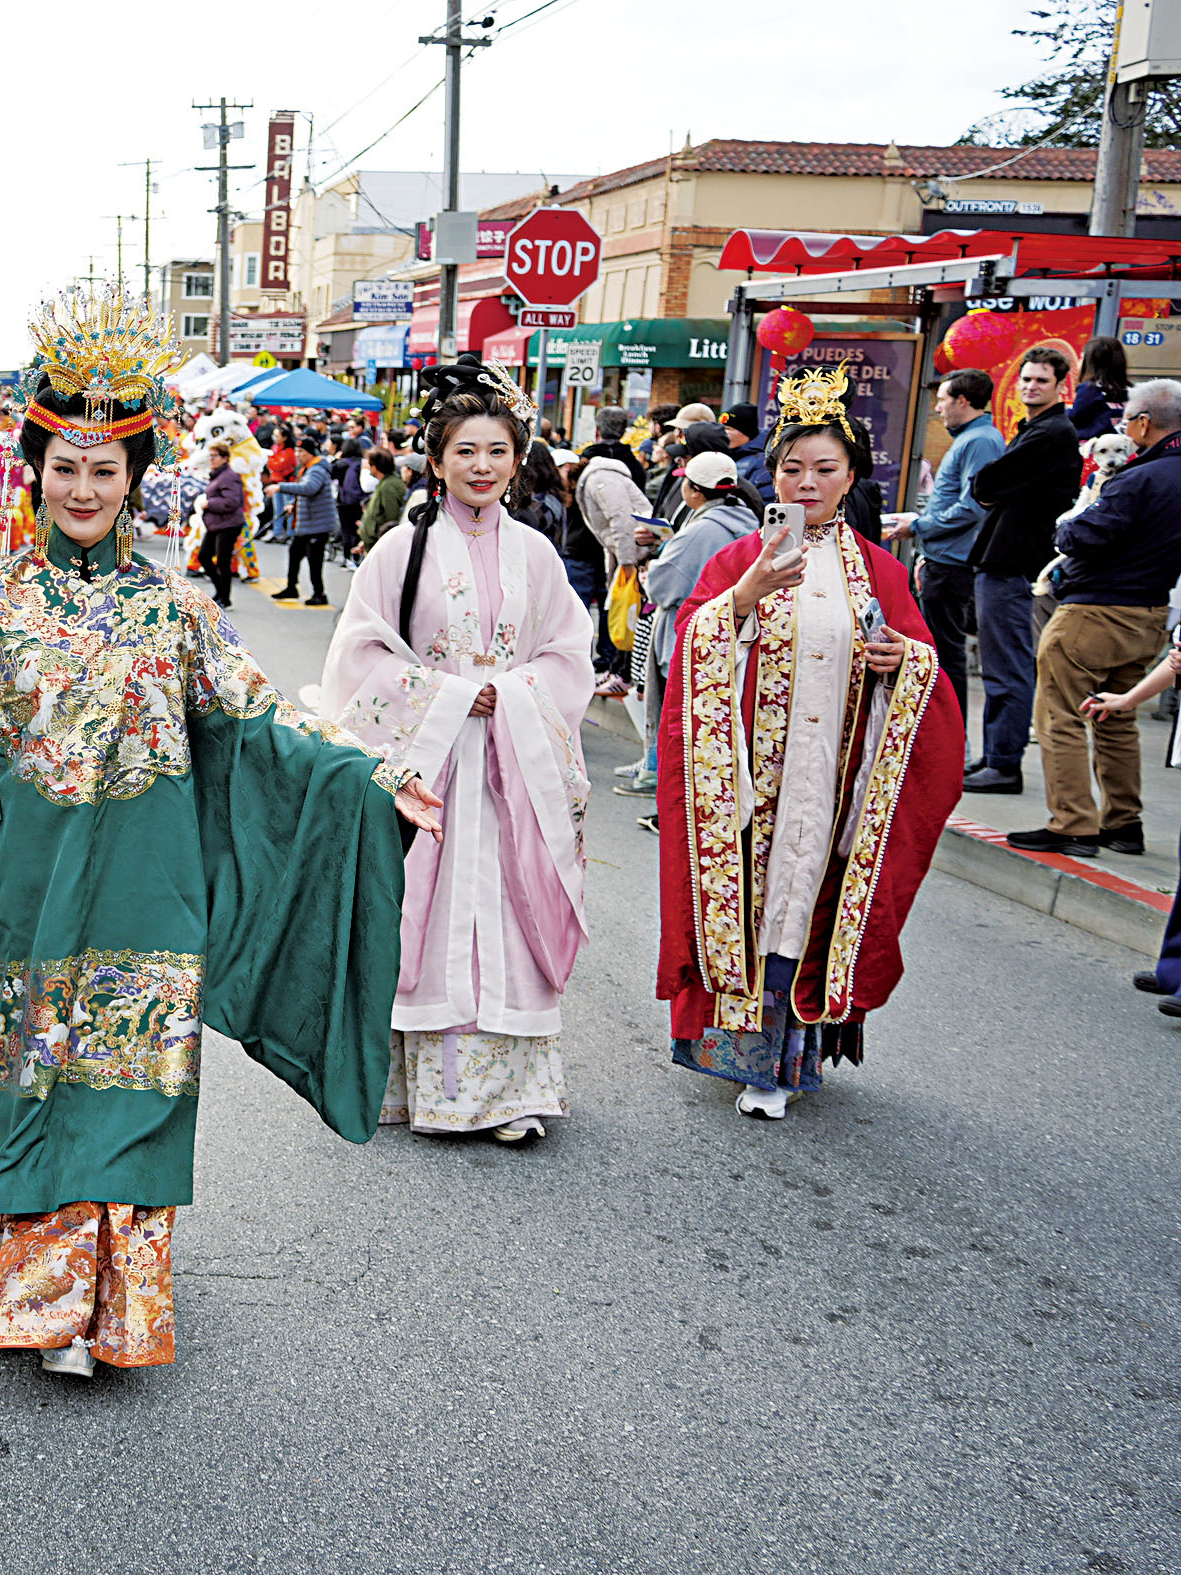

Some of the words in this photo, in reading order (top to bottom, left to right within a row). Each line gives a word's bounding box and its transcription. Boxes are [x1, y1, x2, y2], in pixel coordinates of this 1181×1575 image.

[268, 134, 292, 282] BALBOA
[511, 238, 596, 277] STOP
[524, 313, 545, 325] ALL
[549, 314, 572, 326] WAY
[1155, 323, 1175, 331] STOP
[1125, 333, 1139, 344] 18
[1146, 333, 1161, 344] 31
[570, 348, 598, 356] SPEED
[618, 343, 656, 352] Breakfast
[689, 337, 728, 359] Litt
[802, 348, 864, 362] PUEDES
[569, 366, 594, 381] 20
[862, 365, 890, 380] DEL
